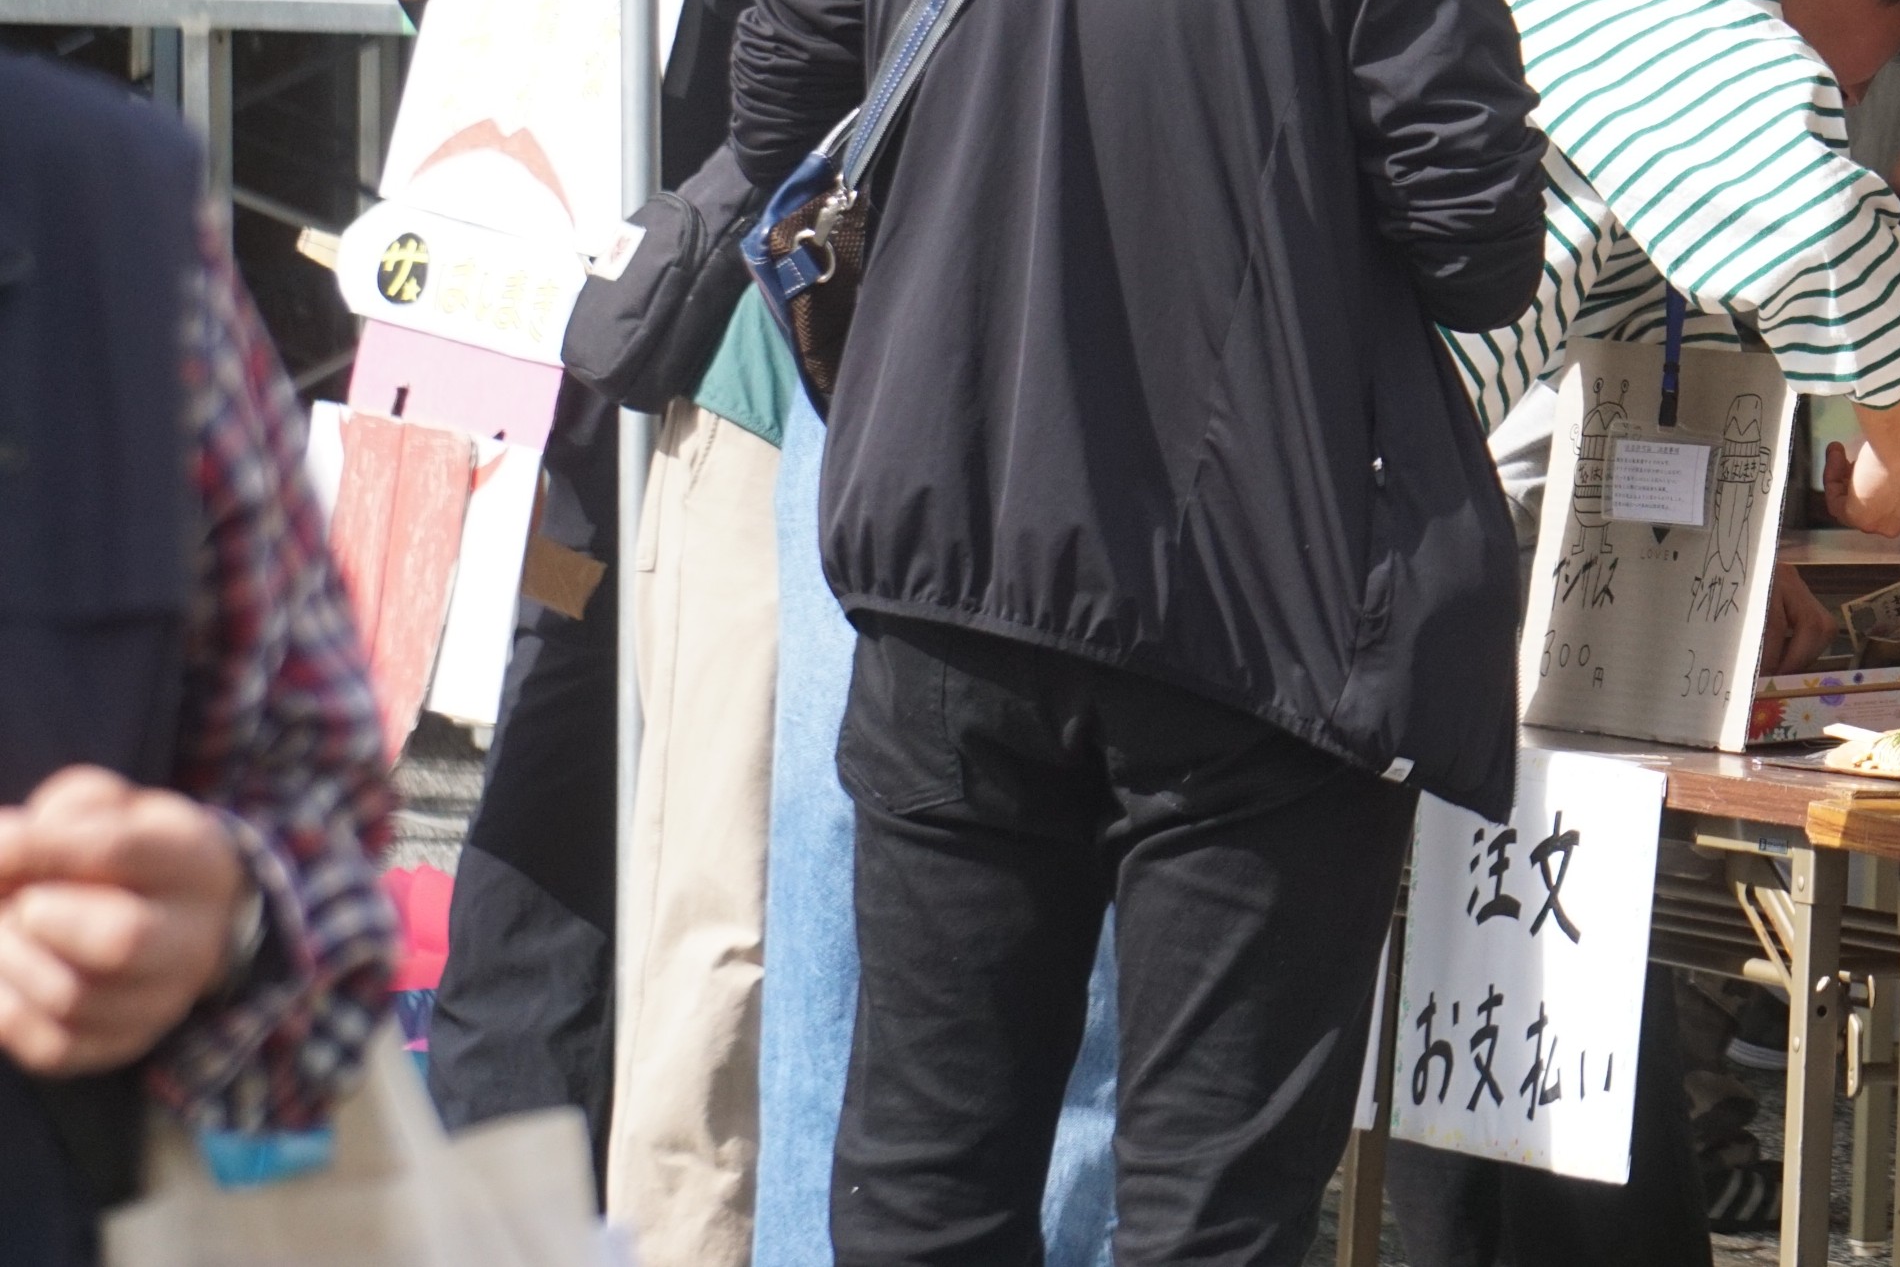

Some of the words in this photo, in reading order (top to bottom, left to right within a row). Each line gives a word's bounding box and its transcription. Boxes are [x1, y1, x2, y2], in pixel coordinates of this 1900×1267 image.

[1466, 810, 1582, 946] 注文
[1411, 983, 1614, 1122] お支払い
